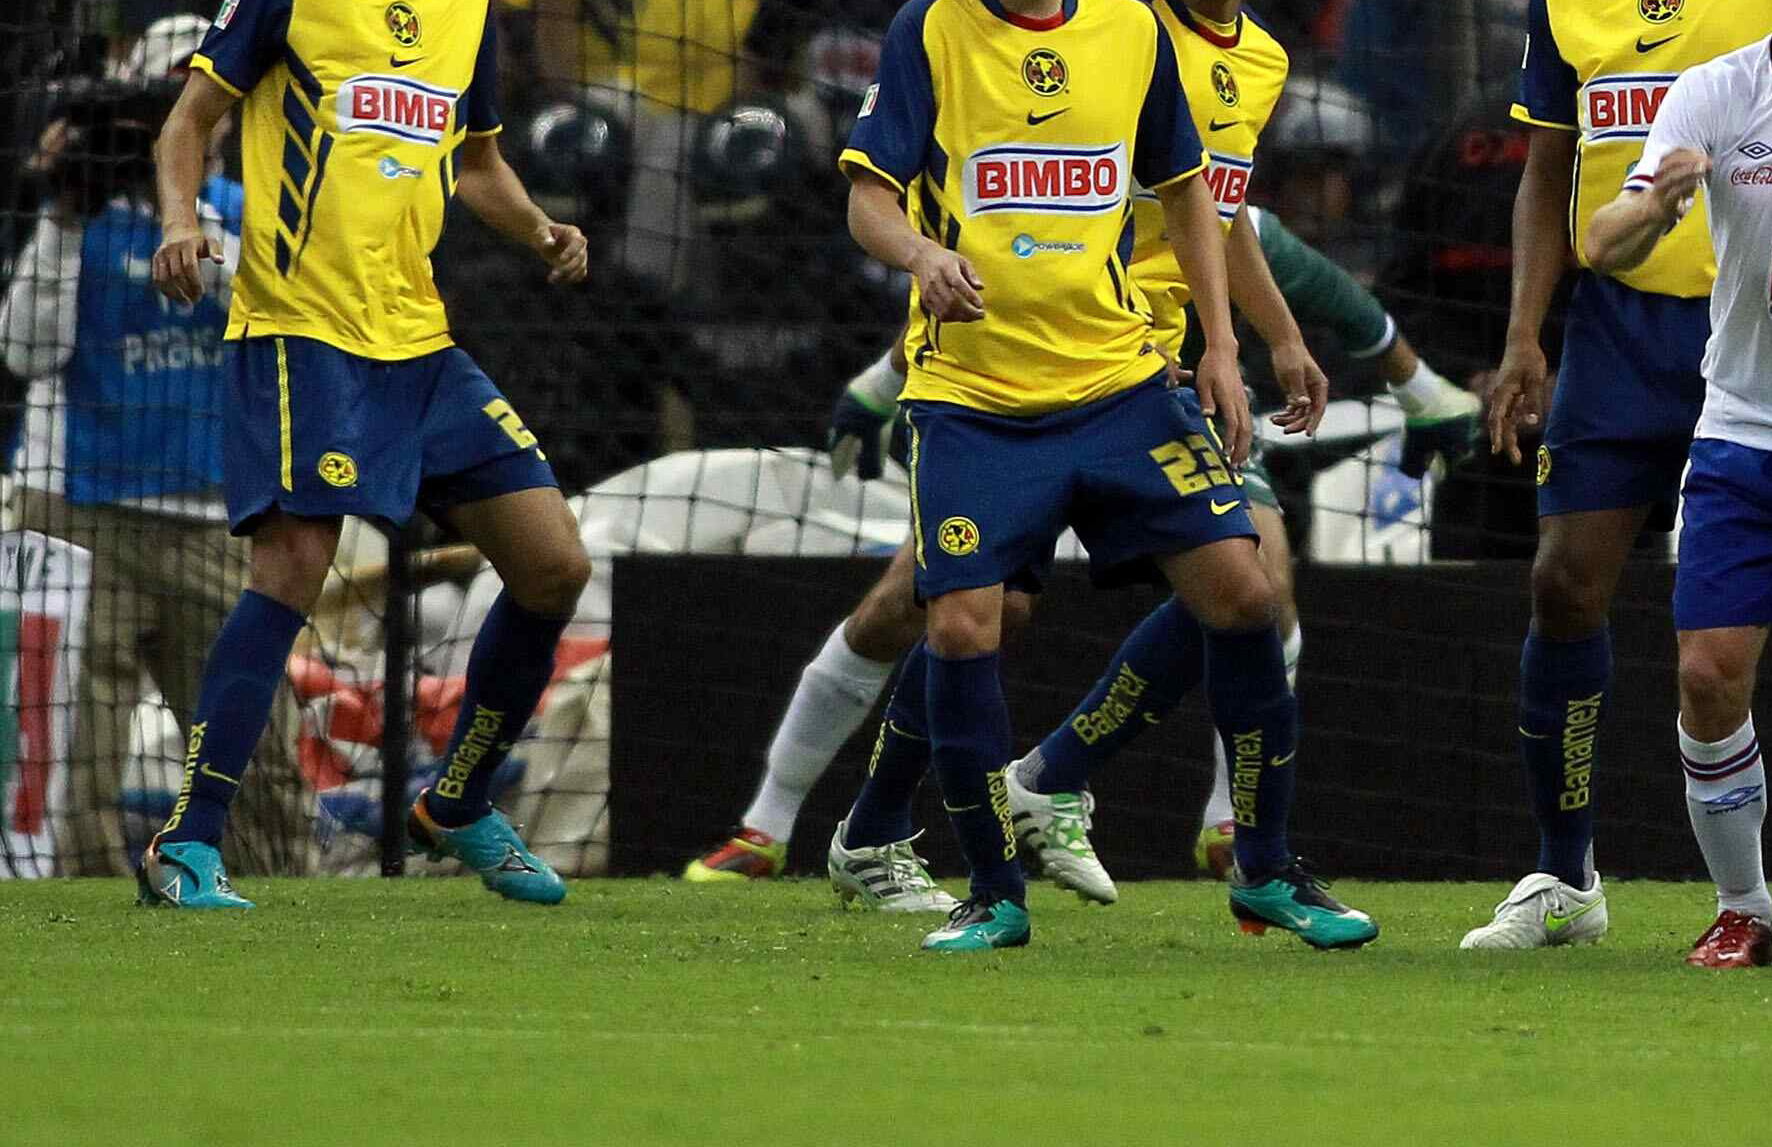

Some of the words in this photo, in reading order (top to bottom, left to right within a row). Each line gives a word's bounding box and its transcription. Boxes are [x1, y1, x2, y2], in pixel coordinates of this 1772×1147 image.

[352, 85, 449, 132] BIMB
[1589, 86, 1668, 128] BIM
[976, 158, 1118, 199] BIMBO
[482, 398, 547, 461] 2
[1072, 661, 1155, 747] Banamex
[437, 704, 505, 800] Banamex
[1232, 728, 1263, 828] Banamex
[1560, 691, 1604, 812] Banamex
